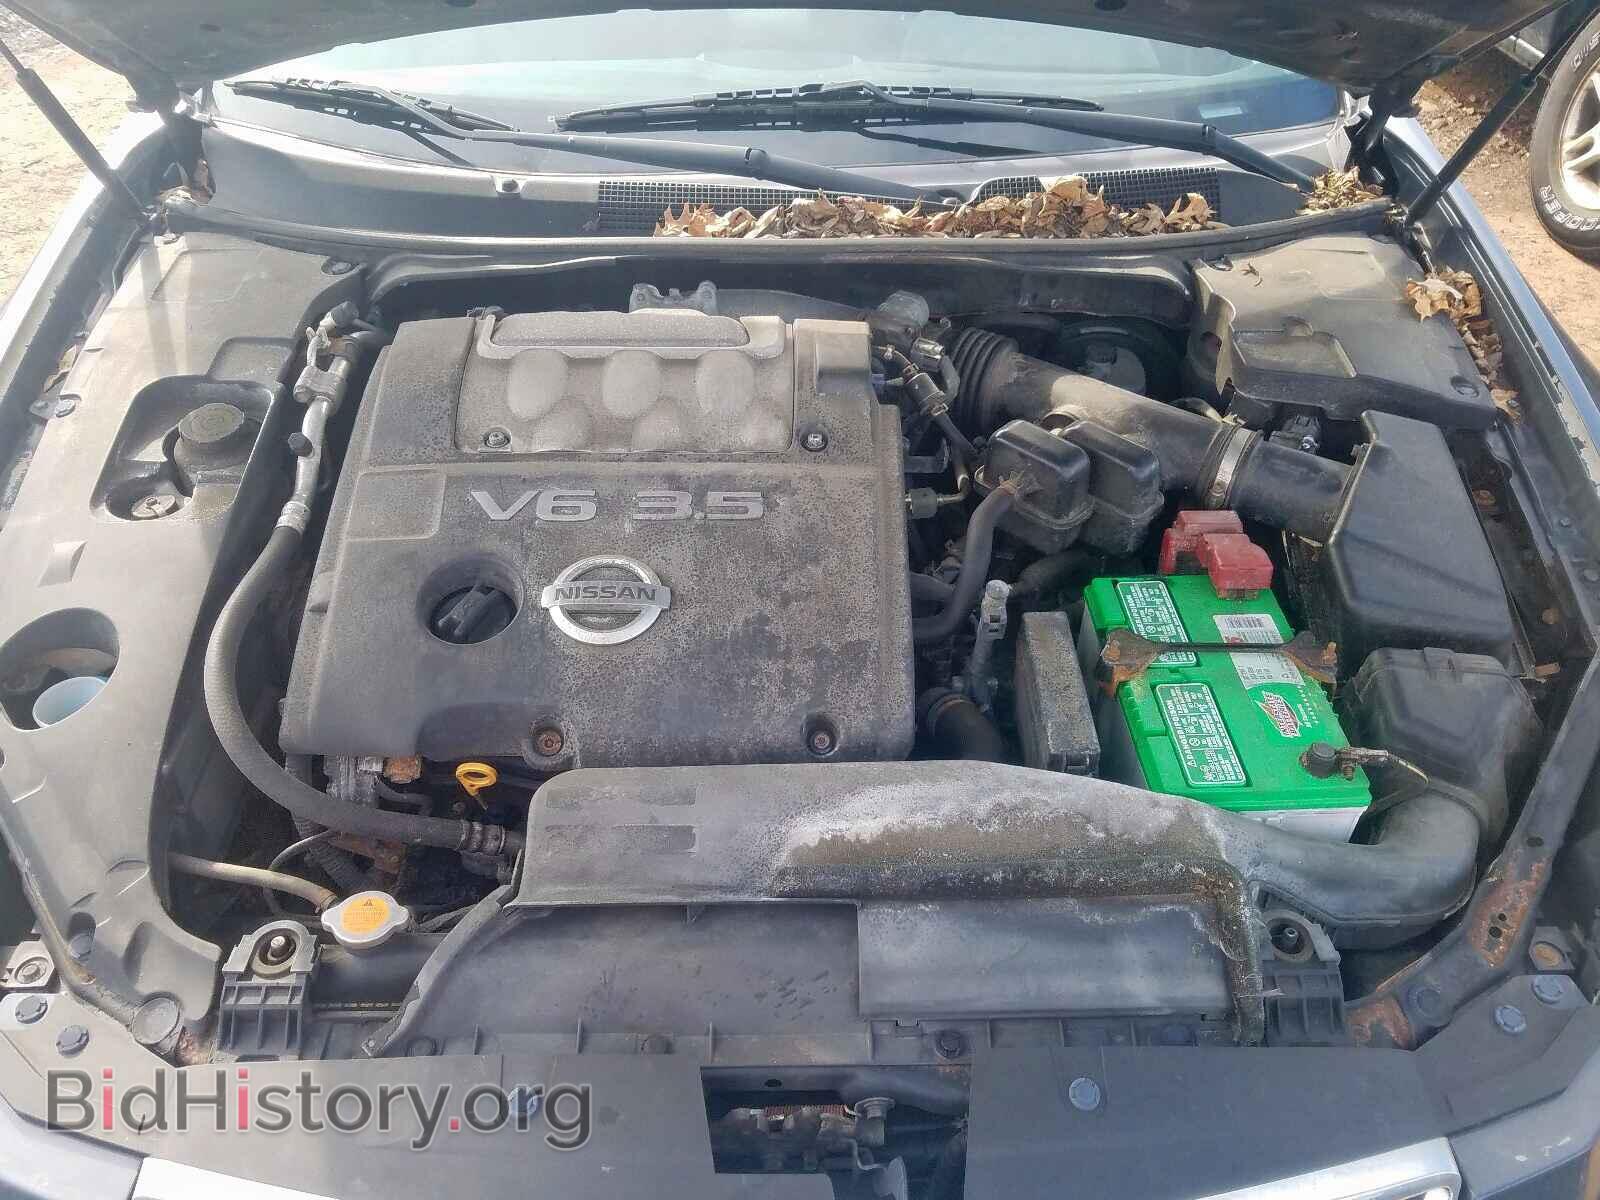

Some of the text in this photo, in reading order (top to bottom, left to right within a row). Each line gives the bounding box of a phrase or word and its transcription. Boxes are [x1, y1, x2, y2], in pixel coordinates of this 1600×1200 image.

[1540, 185, 1600, 231] OOPER
[471, 489, 766, 521] V6 3.5
[554, 585, 657, 602] NISSAN
